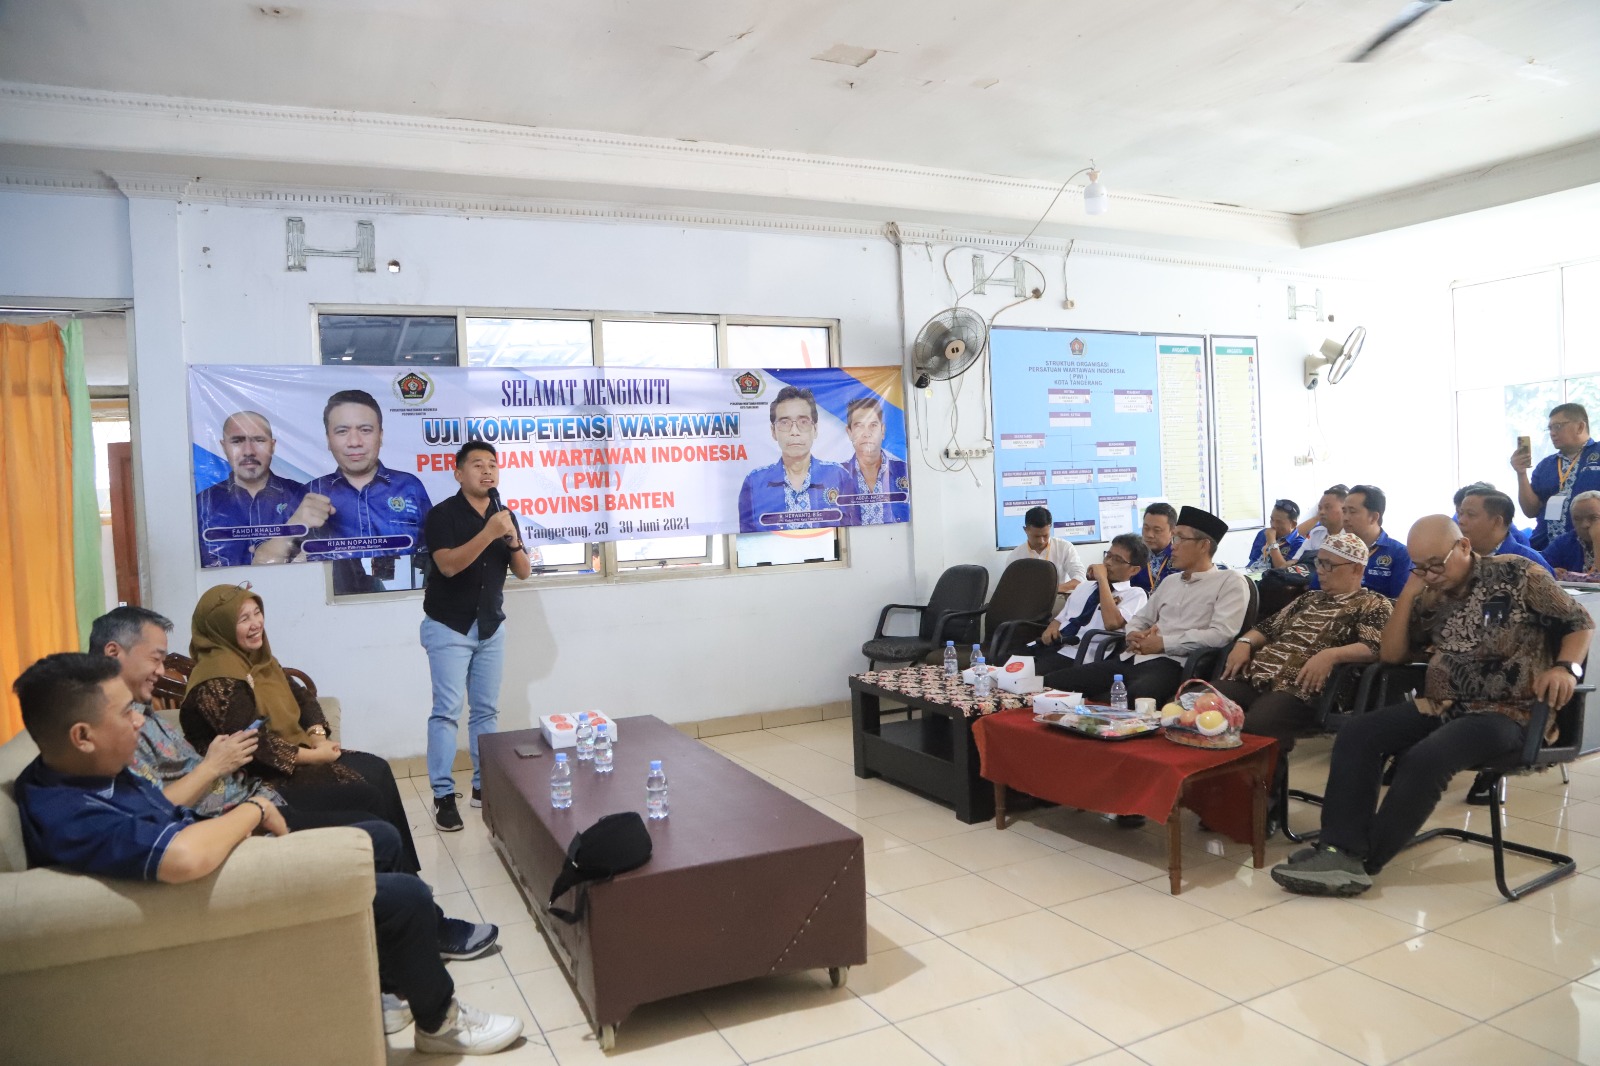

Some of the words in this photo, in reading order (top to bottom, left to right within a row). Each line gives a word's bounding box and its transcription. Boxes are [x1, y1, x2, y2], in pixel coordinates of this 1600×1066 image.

[502, 379, 577, 407] SELAMAT
[583, 379, 670, 406] MENGIKUTI
[423, 418, 461, 445] UJI
[466, 416, 613, 442] KOMPETENSI
[618, 413, 739, 439] WARTAWAN
[416, 451, 534, 472] PERUAN
[539, 447, 646, 467] WARTAWAN
[652, 444, 748, 463] INDONESIA
[507, 494, 599, 516] PROVINSI
[604, 492, 674, 511] BANTEN
[525, 525, 591, 540] Tangerang,
[594, 521, 609, 535] 29
[619, 520, 633, 533] 30
[636, 519, 660, 532] Juni
[663, 517, 689, 531] 2024
